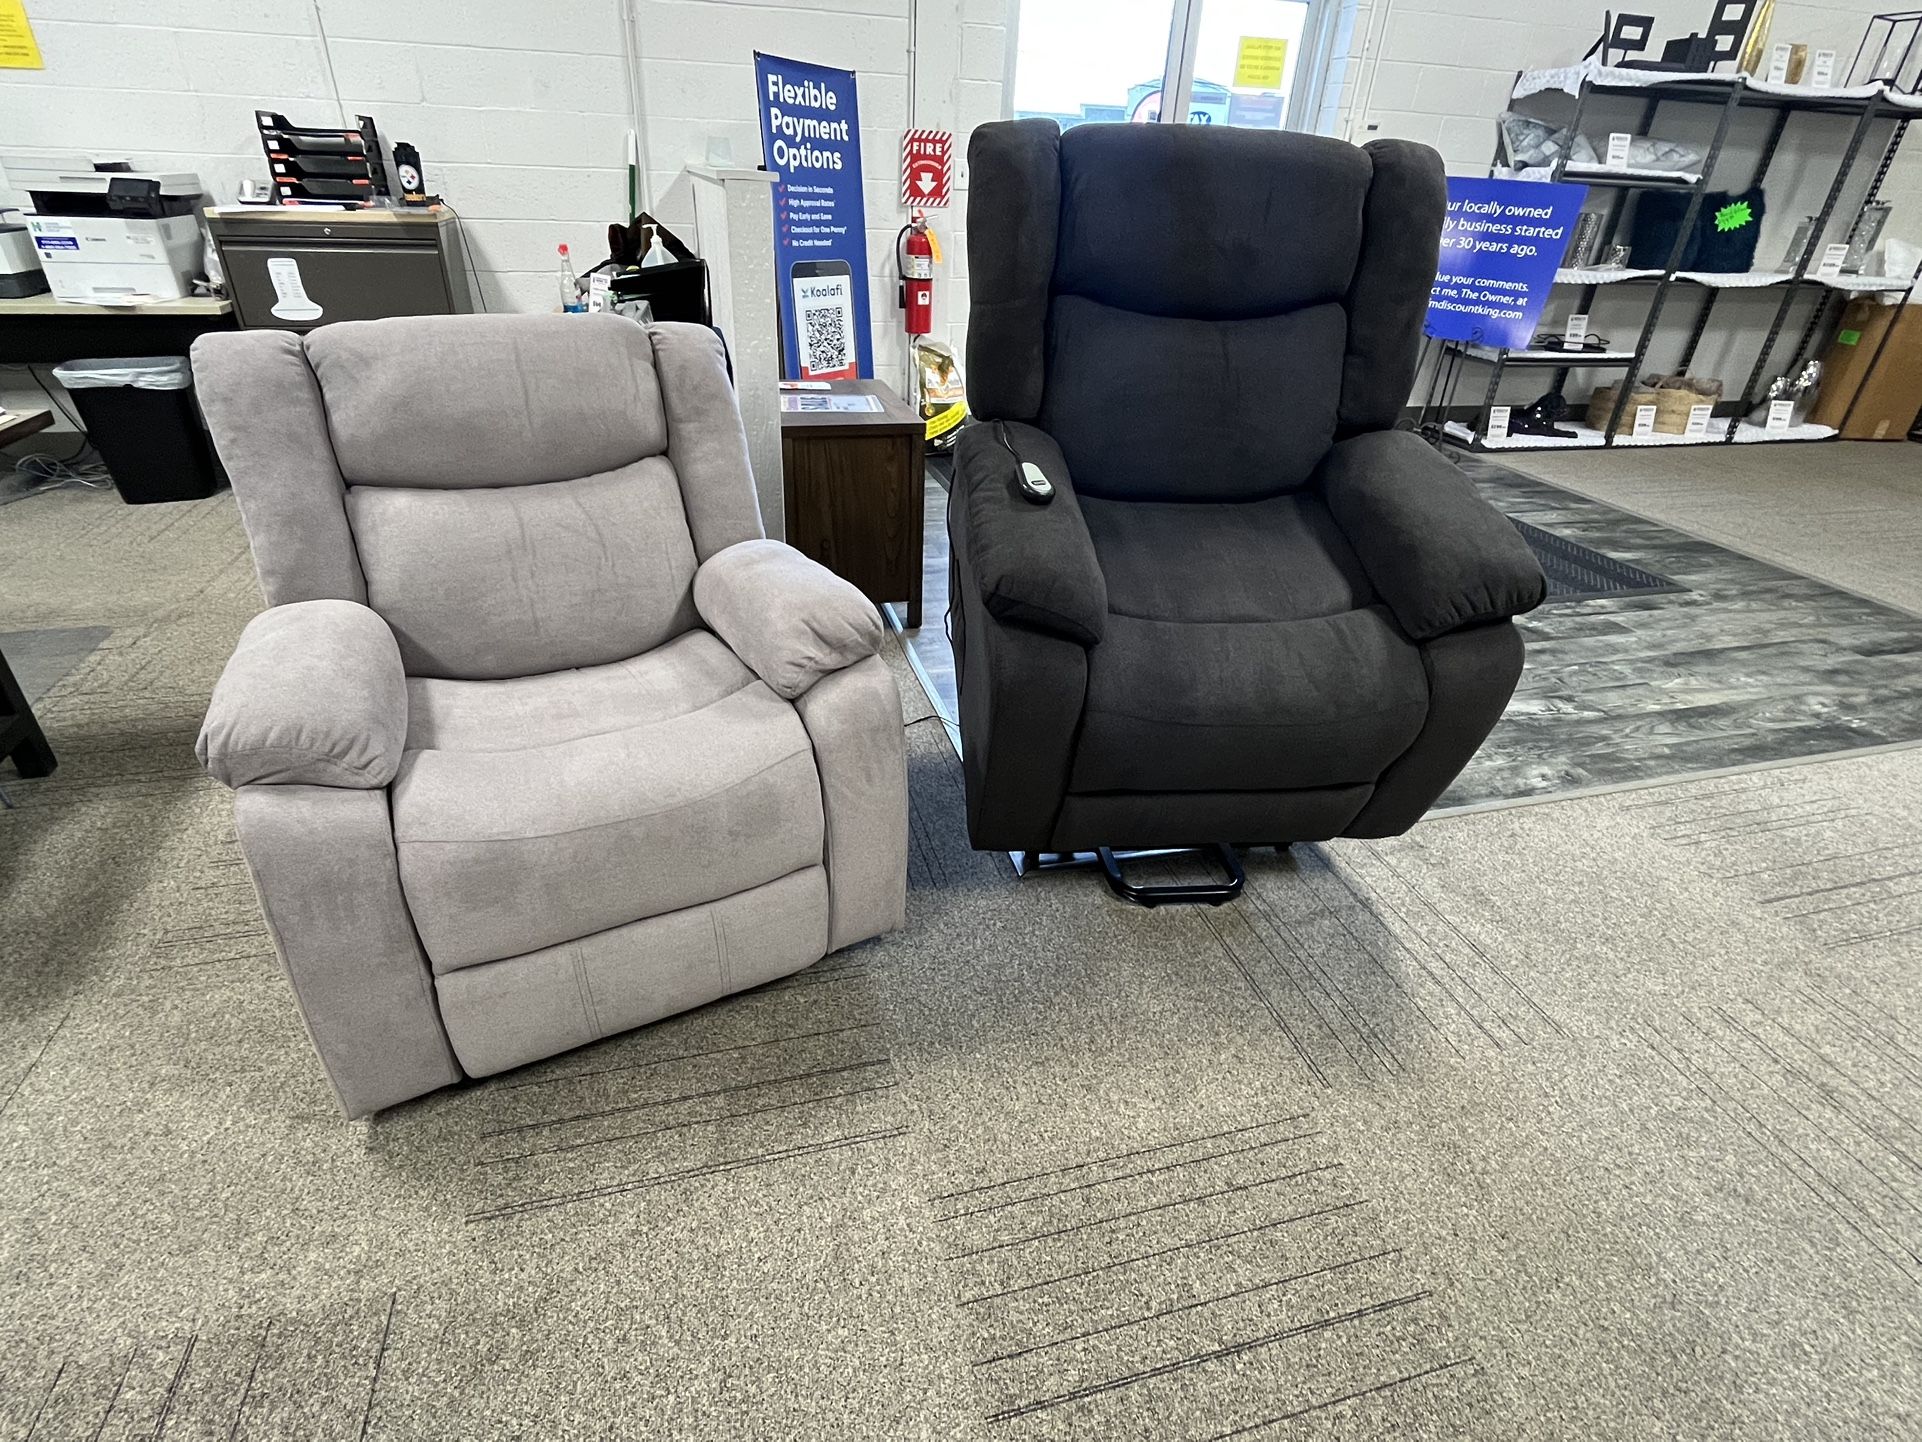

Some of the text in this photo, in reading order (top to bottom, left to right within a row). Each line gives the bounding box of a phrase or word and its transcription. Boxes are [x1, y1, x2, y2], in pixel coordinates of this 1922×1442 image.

[768, 74, 836, 110] Flexible
[770, 107, 848, 142] Payment
[773, 139, 842, 172] Options
[912, 142, 943, 156] FIRE
[787, 184, 808, 192] Decision
[813, 186, 834, 194] Seconds
[788, 198, 800, 208] High
[800, 199, 820, 207] Approval
[1463, 200, 1504, 217] locally
[1505, 205, 1553, 219] owned
[790, 212, 798, 221] Pay
[799, 212, 810, 221] Early
[1458, 218, 1512, 234] business
[1514, 225, 1564, 239] started
[799, 239, 814, 247] Credit
[1456, 236, 1473, 249] 30
[1474, 240, 1508, 252] years
[1510, 244, 1538, 258] ago.
[810, 284, 843, 298] Koalafi
[1451, 276, 1474, 285] your
[1475, 278, 1529, 292] comments.
[1442, 288, 1459, 299] me,
[1461, 288, 1479, 300] The
[1480, 291, 1515, 306] Owner,
[1516, 297, 1528, 306] at
